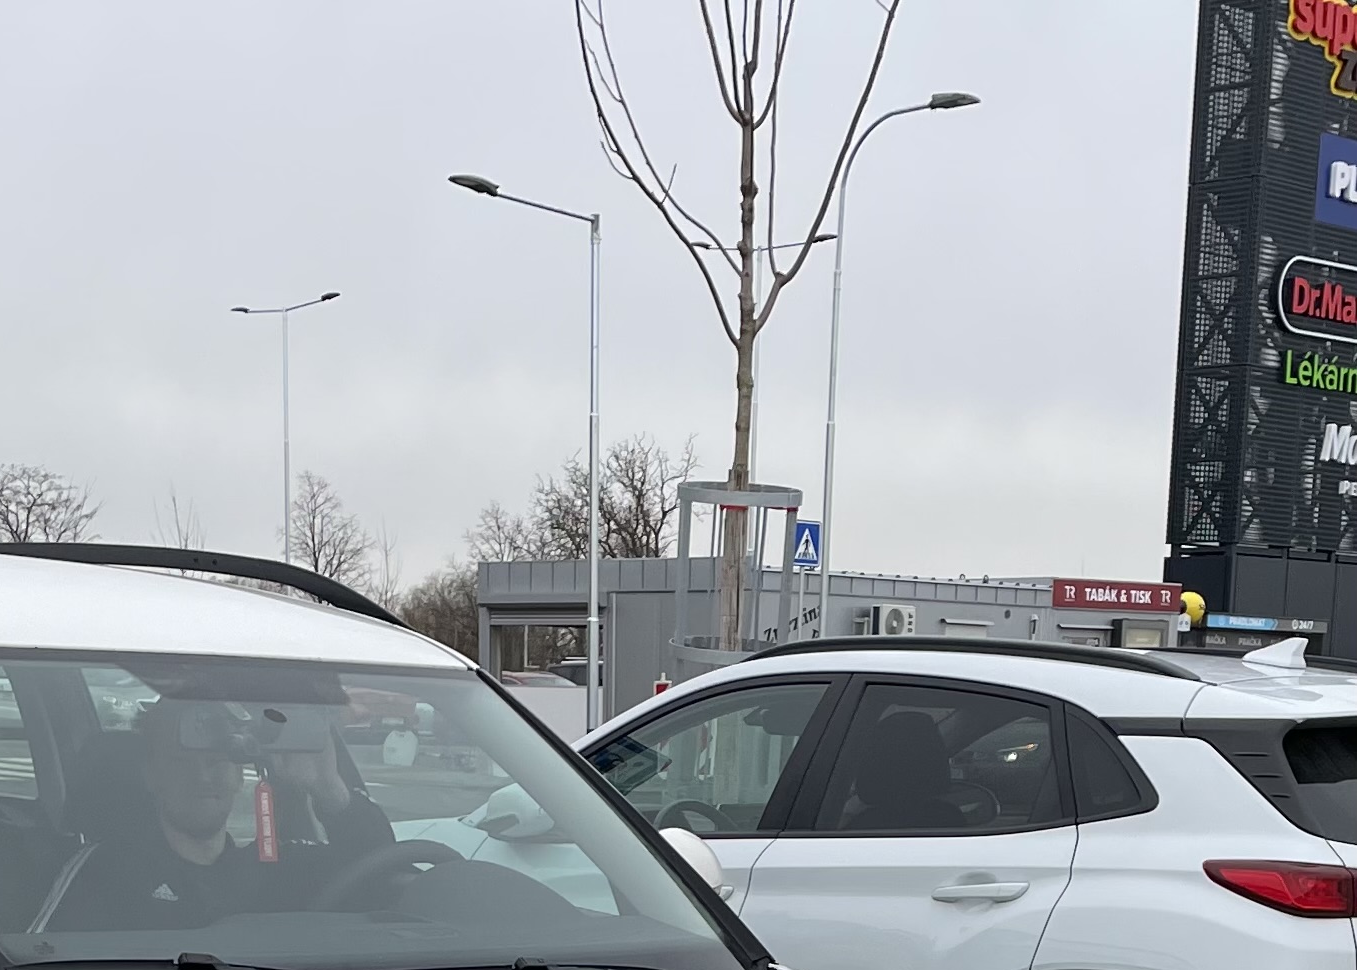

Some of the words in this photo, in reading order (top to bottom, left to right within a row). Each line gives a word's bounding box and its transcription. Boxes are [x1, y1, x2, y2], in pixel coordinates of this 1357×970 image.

[1295, 0, 1357, 55] sup
[1084, 585, 1118, 602] TABÁK
[1120, 589, 1128, 603] &
[1130, 590, 1153, 604] TISK
[1298, 620, 1314, 630] 24/7
